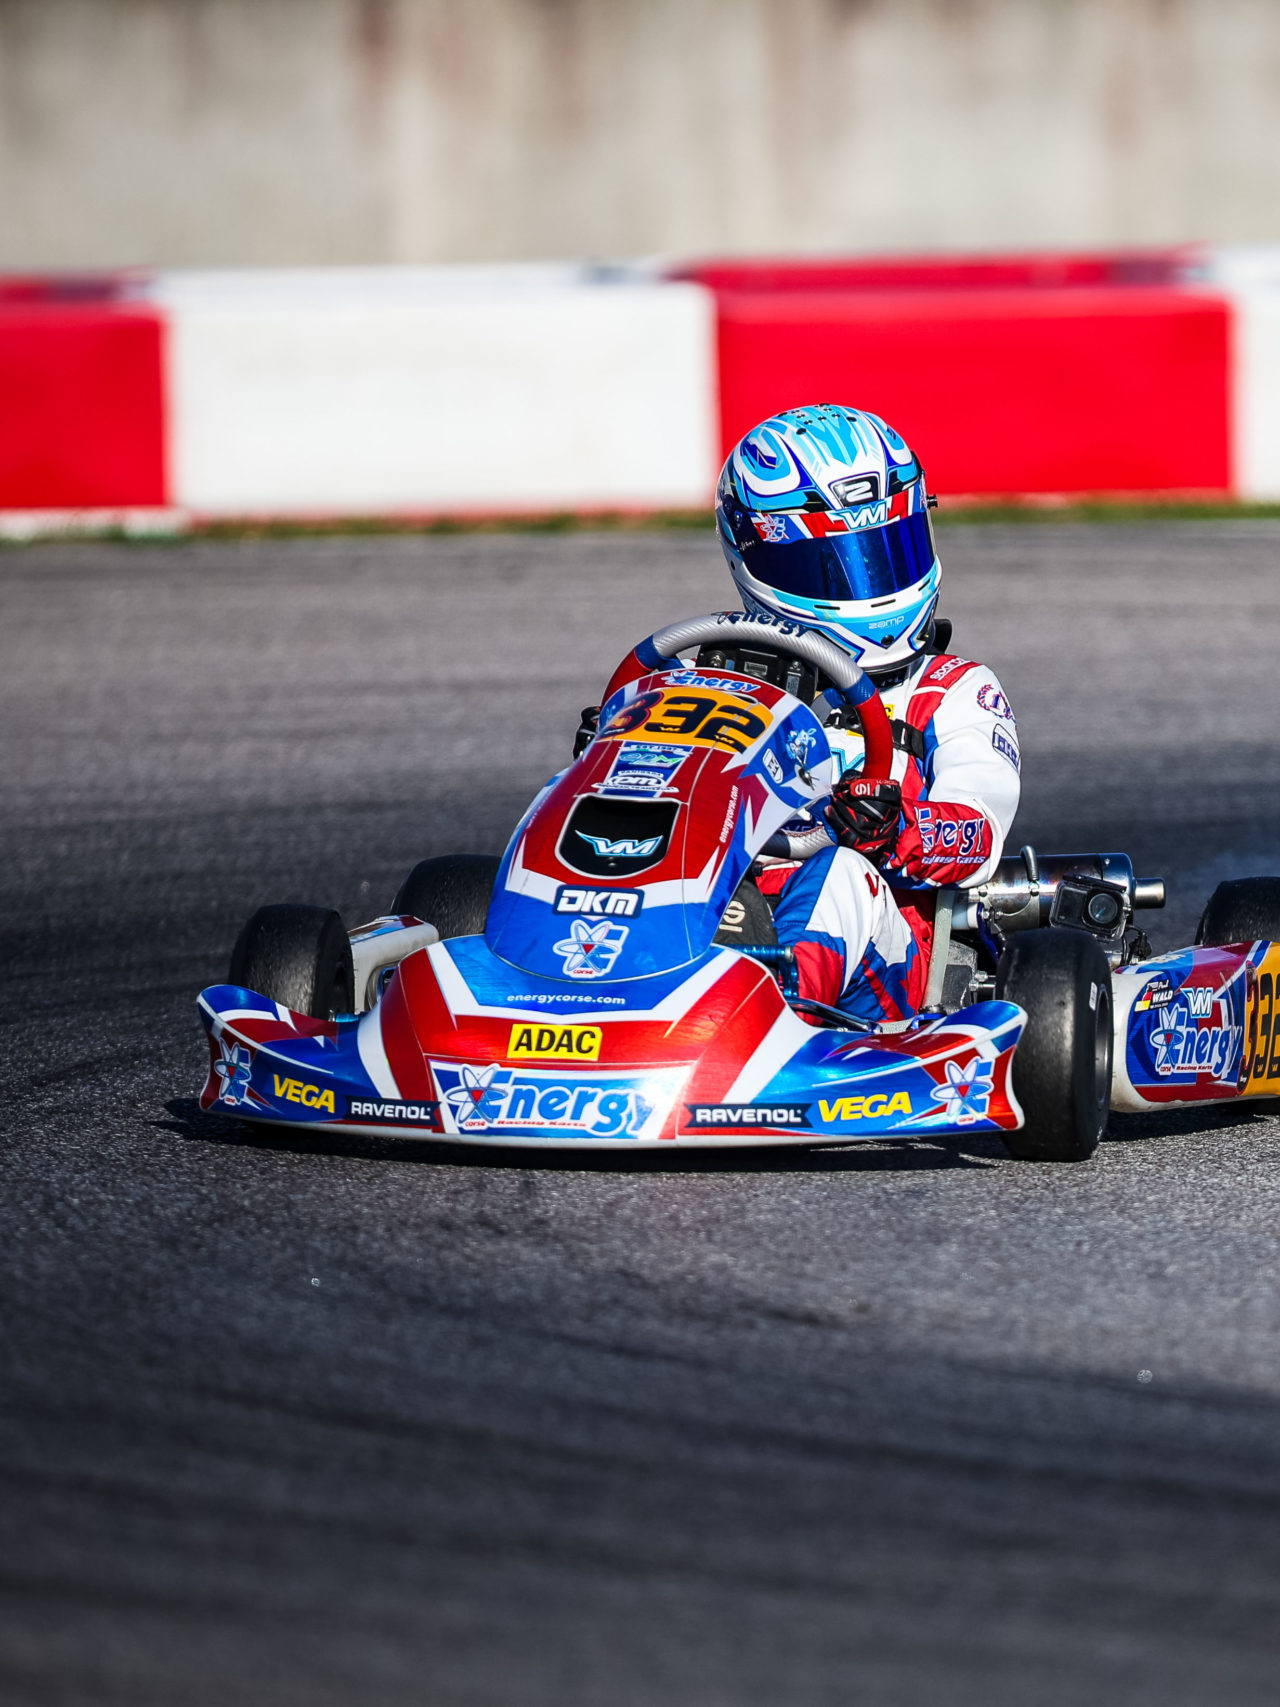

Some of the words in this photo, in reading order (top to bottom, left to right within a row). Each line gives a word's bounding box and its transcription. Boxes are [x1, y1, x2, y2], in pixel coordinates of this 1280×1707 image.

[868, 615, 905, 629] zamp
[662, 671, 761, 692] Energy
[556, 889, 639, 916] DKM
[507, 994, 626, 1005] energycorse.com
[513, 1028, 597, 1054] ADAC
[1150, 1003, 1243, 1077] Energy
[273, 1074, 336, 1114] VEGA
[447, 1064, 657, 1134] Energy
[818, 1092, 912, 1122] VEGA
[351, 1101, 432, 1120] RAVENOL
[695, 1108, 802, 1124] RAVENOL
